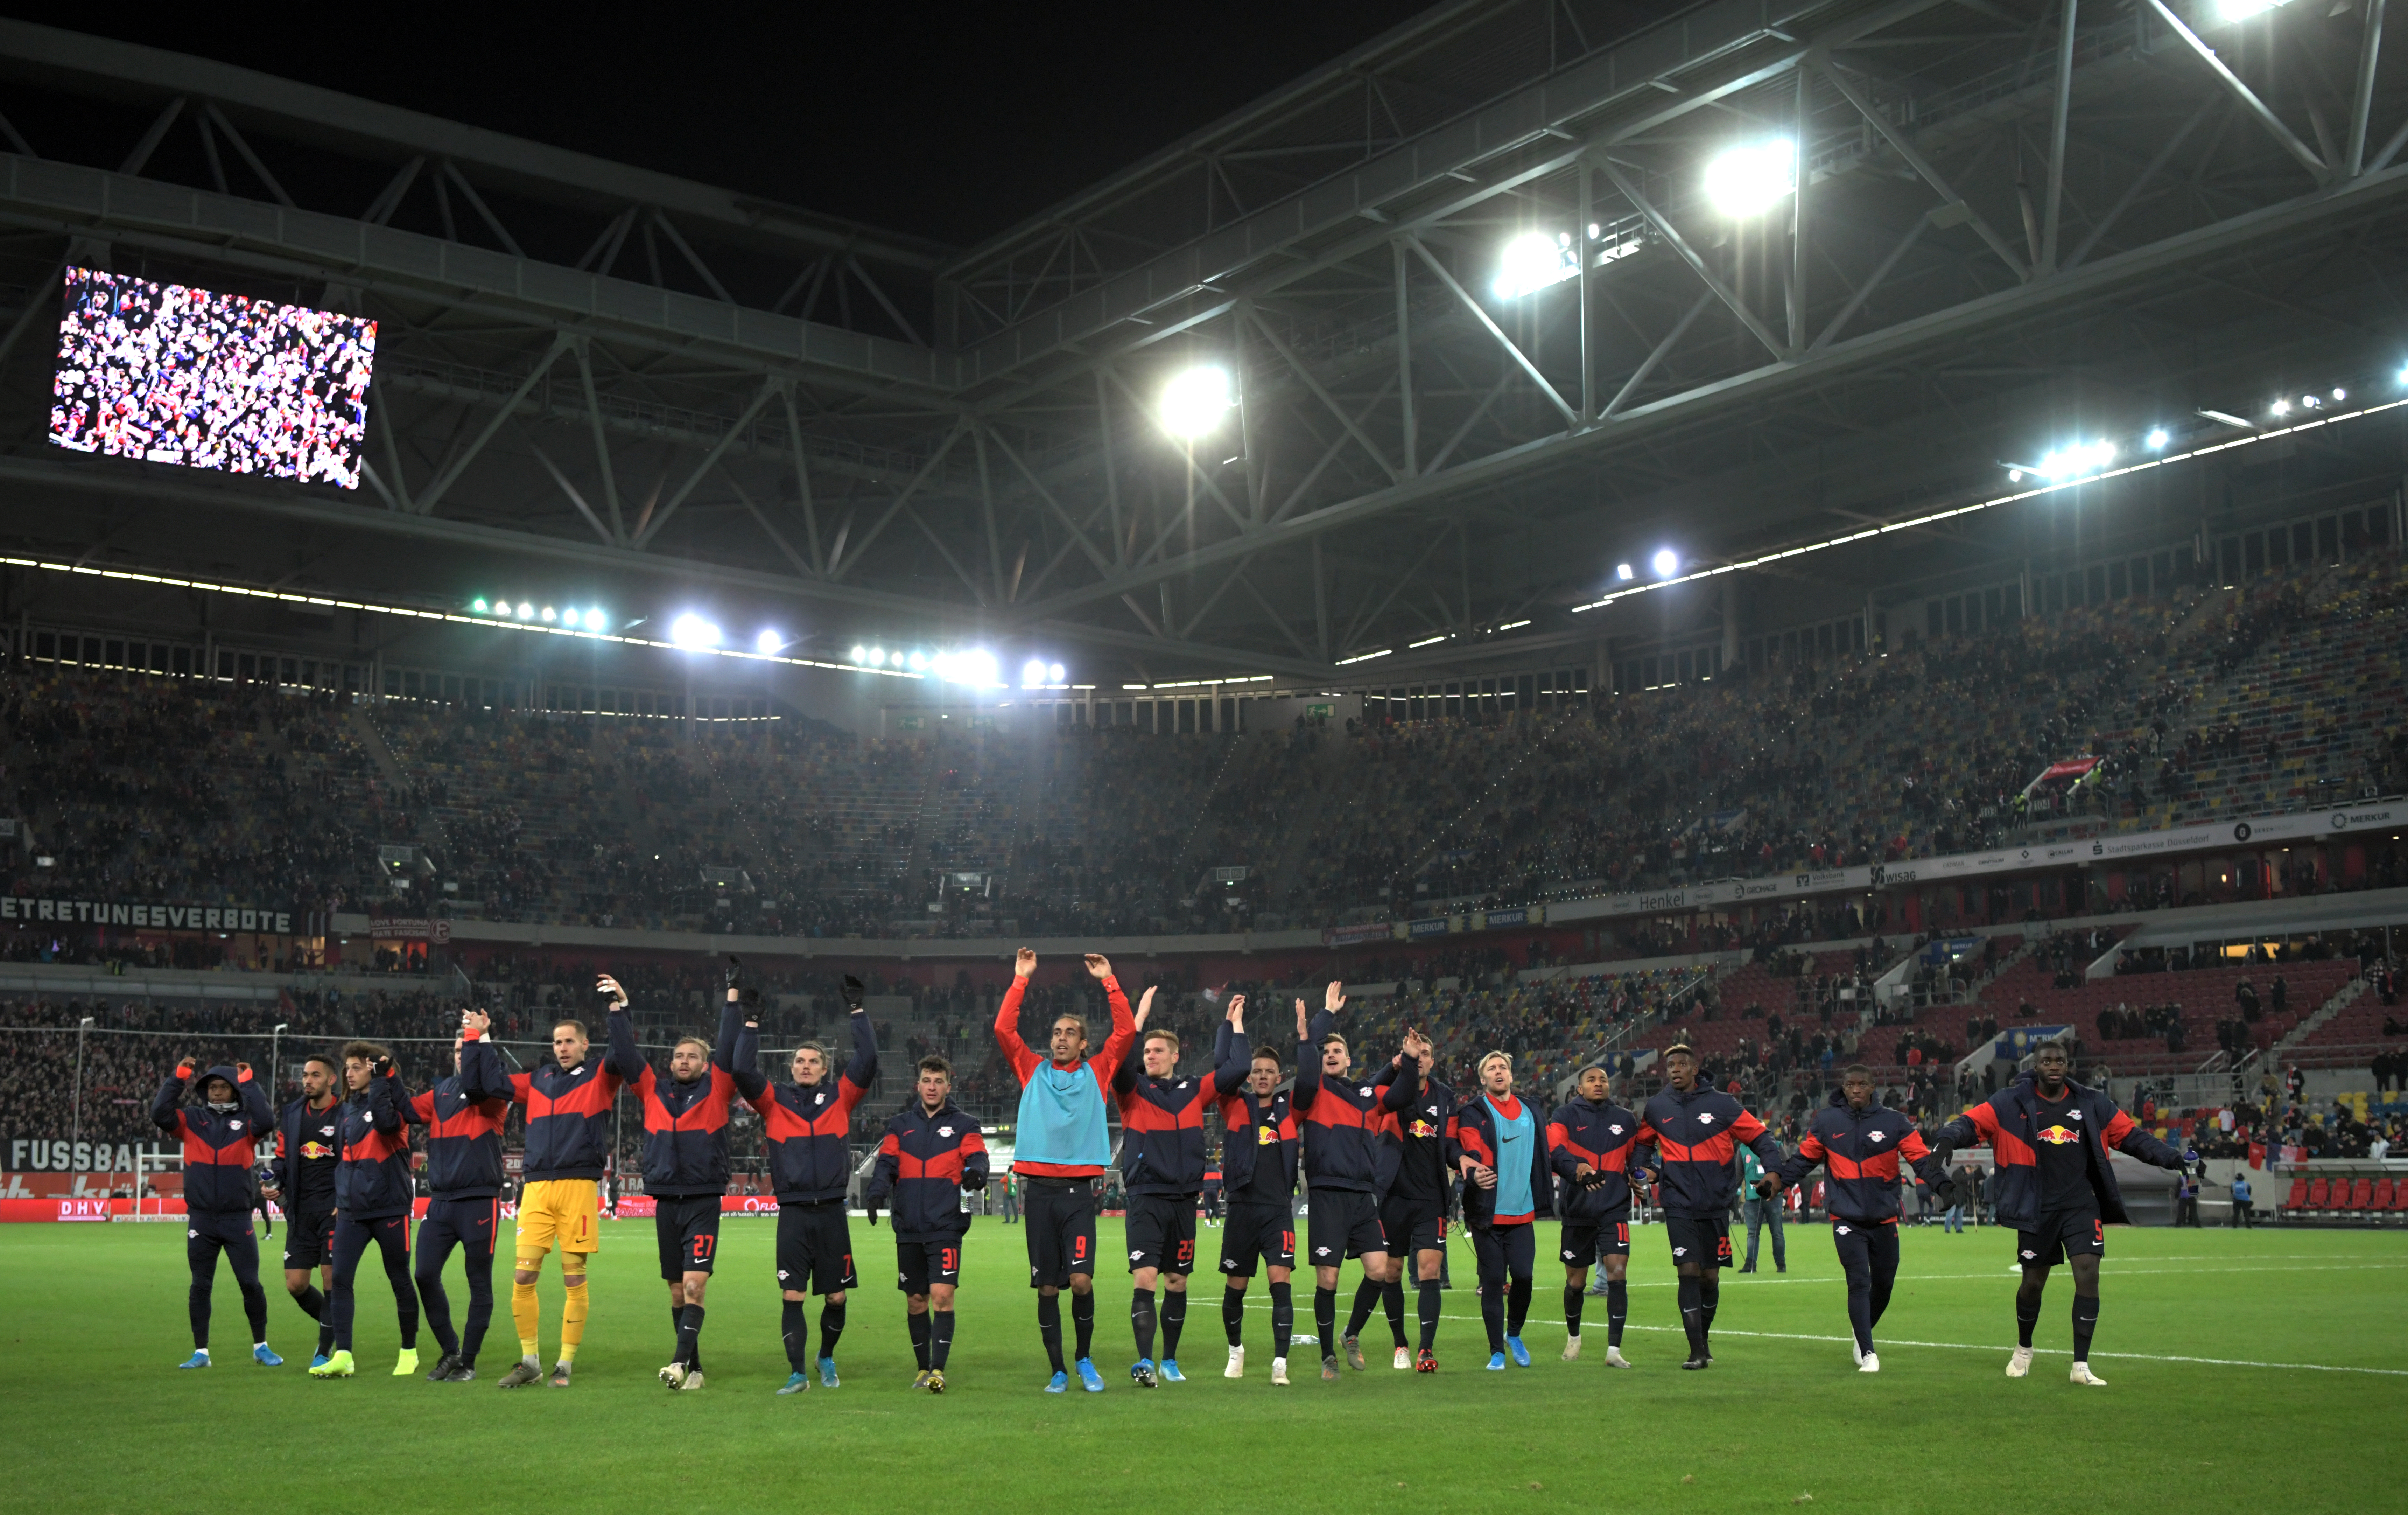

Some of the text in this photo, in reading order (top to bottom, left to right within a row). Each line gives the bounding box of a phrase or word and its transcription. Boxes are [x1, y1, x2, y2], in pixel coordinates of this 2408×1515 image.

[2351, 812, 2390, 823] MERKUR
[2107, 835, 2209, 854] Stadtsparkasse Düsseldorf
[1813, 871, 1845, 881] Volksbank
[1640, 891, 1684, 910] Henkel
[1413, 921, 1445, 934] MERKUR
[1489, 912, 1524, 924] MERKUR
[12, 1139, 166, 1172] FUSSBALL
[62, 1201, 104, 1215] DHV
[582, 1215, 587, 1236] 1
[693, 1234, 714, 1257] 27
[1075, 1235, 1087, 1259] 9
[1177, 1239, 1194, 1260] 23
[1282, 1230, 1295, 1253] 19
[843, 1254, 851, 1277] 7
[942, 1248, 958, 1270] 31
